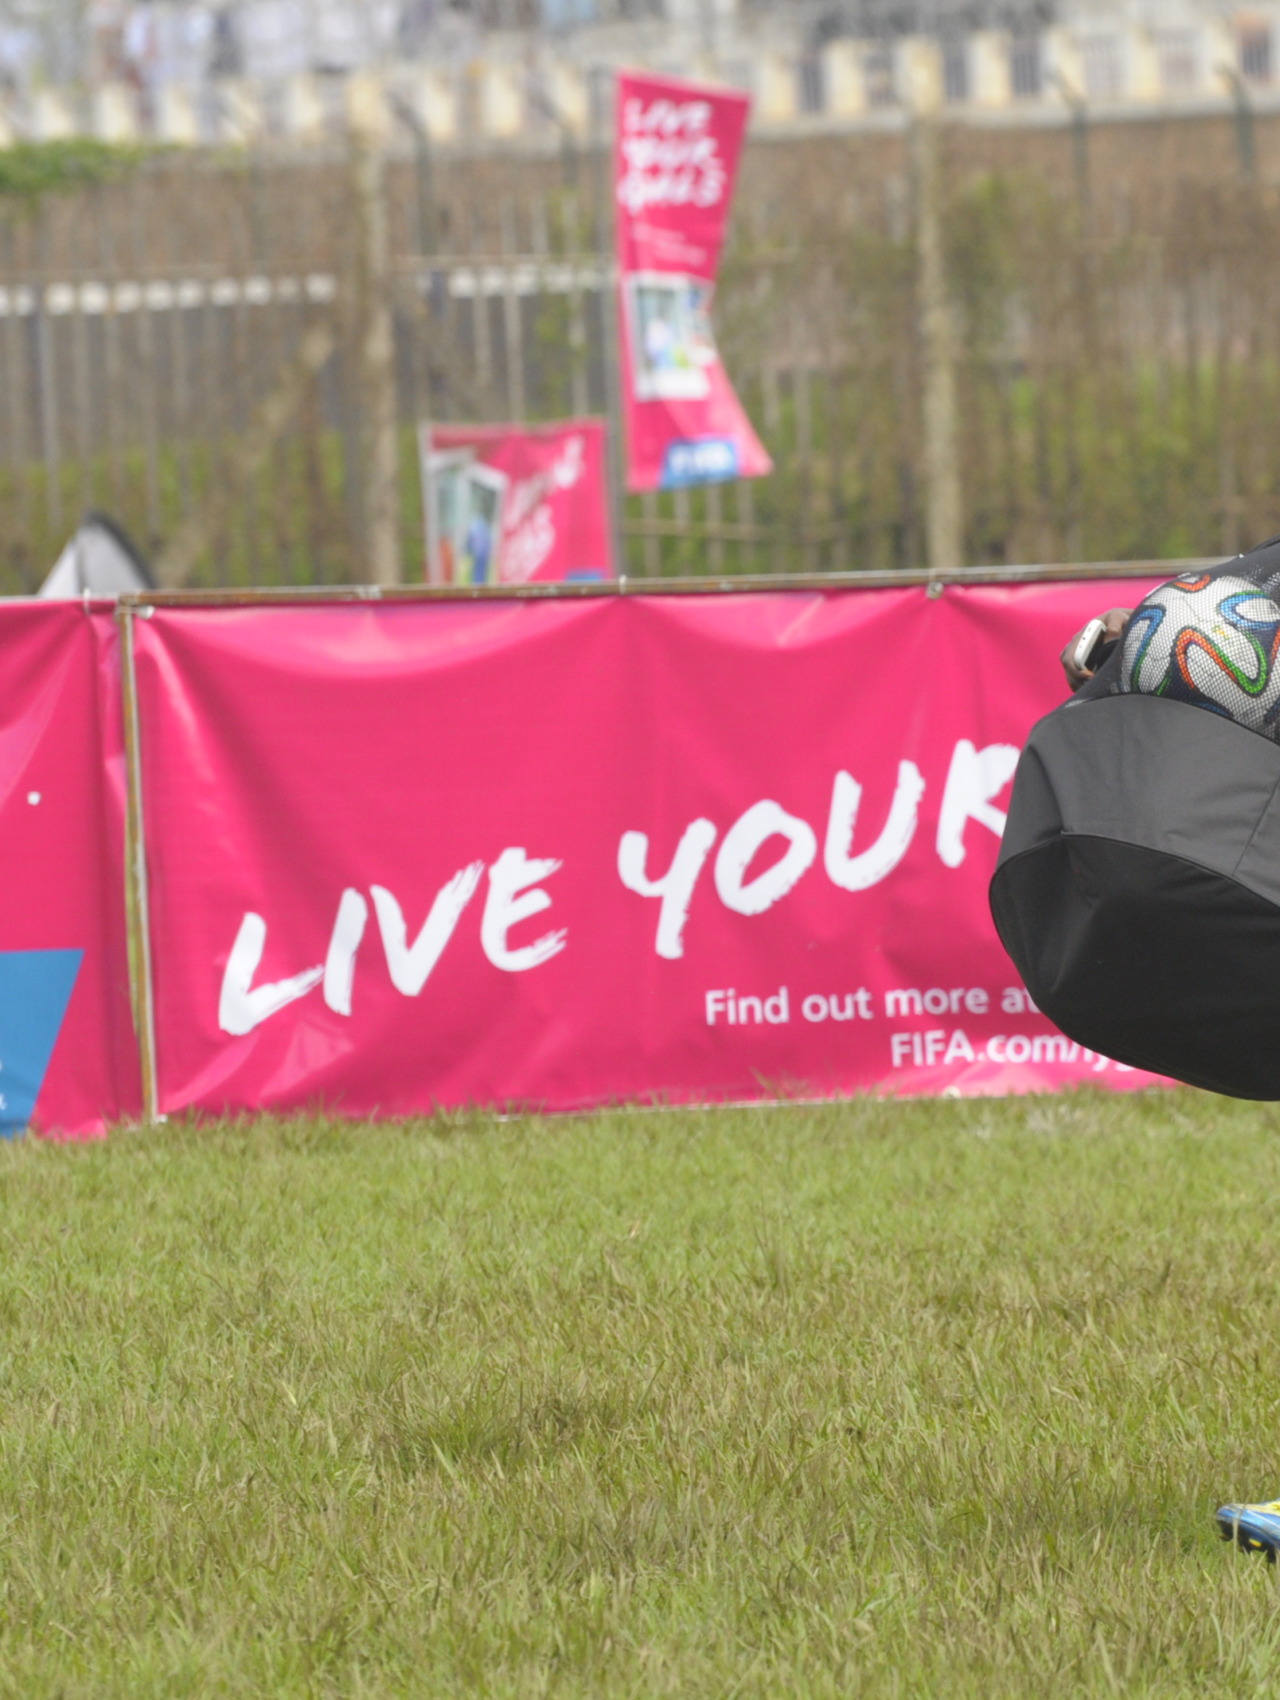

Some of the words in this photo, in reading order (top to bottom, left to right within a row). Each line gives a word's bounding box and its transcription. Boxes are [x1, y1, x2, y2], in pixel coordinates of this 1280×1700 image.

[217, 845, 568, 1037] LIVE
[704, 986, 790, 1026] Find
[801, 986, 874, 1023] out
[884, 987, 989, 1018] more
